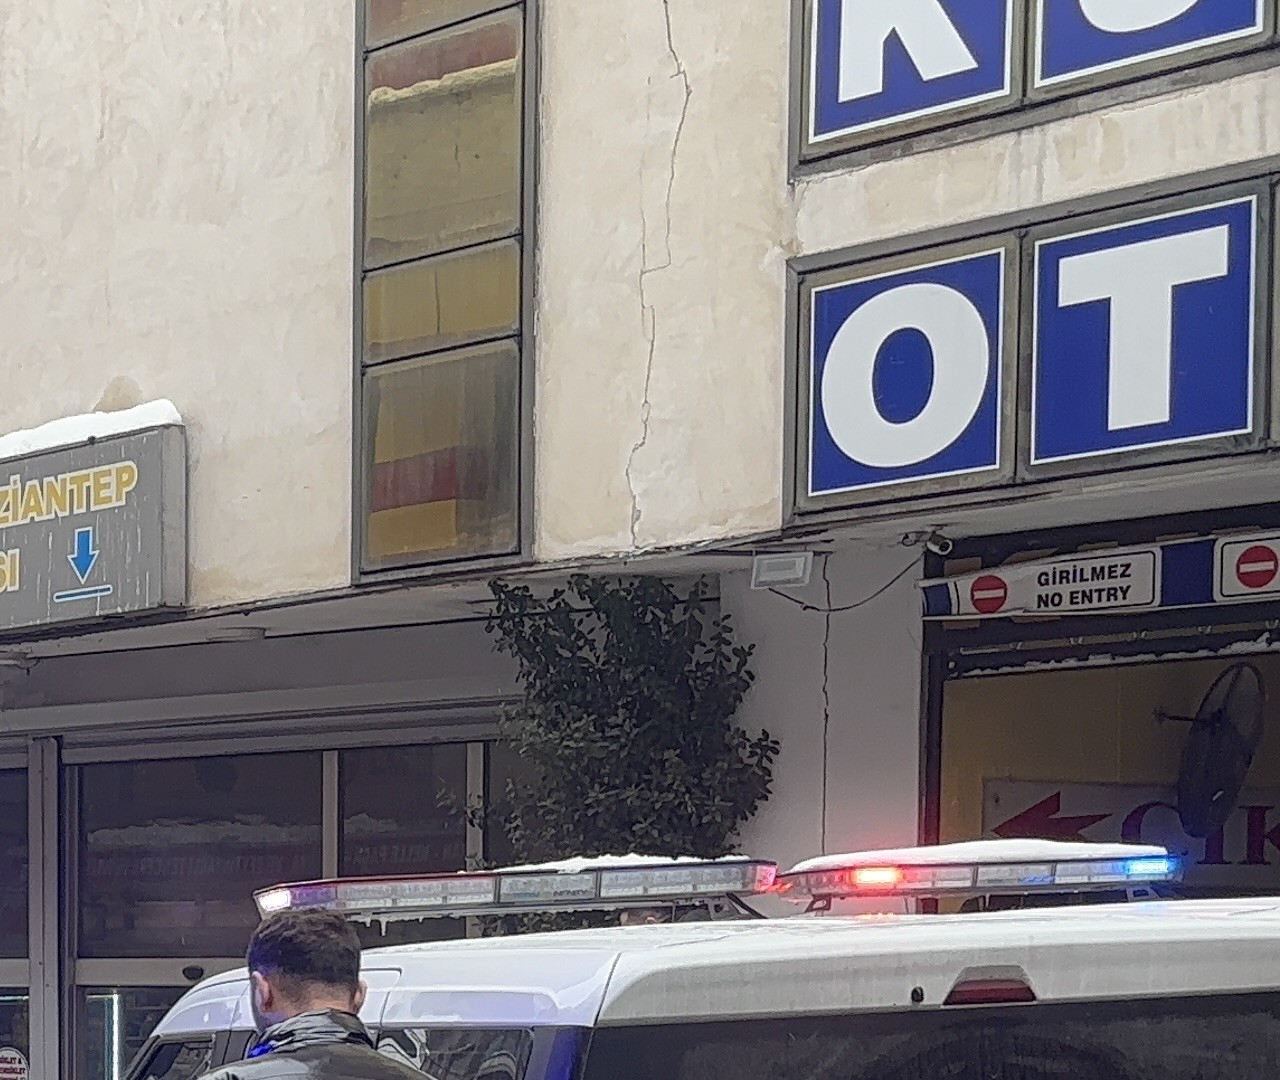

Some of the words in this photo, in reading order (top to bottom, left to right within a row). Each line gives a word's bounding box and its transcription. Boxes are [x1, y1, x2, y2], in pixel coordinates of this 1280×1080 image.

[821, 224, 1229, 468] OT
[1037, 562, 1132, 587] GİRİLMEZ
[1037, 593, 1063, 608] NO
[1069, 585, 1132, 605] ENTRY
